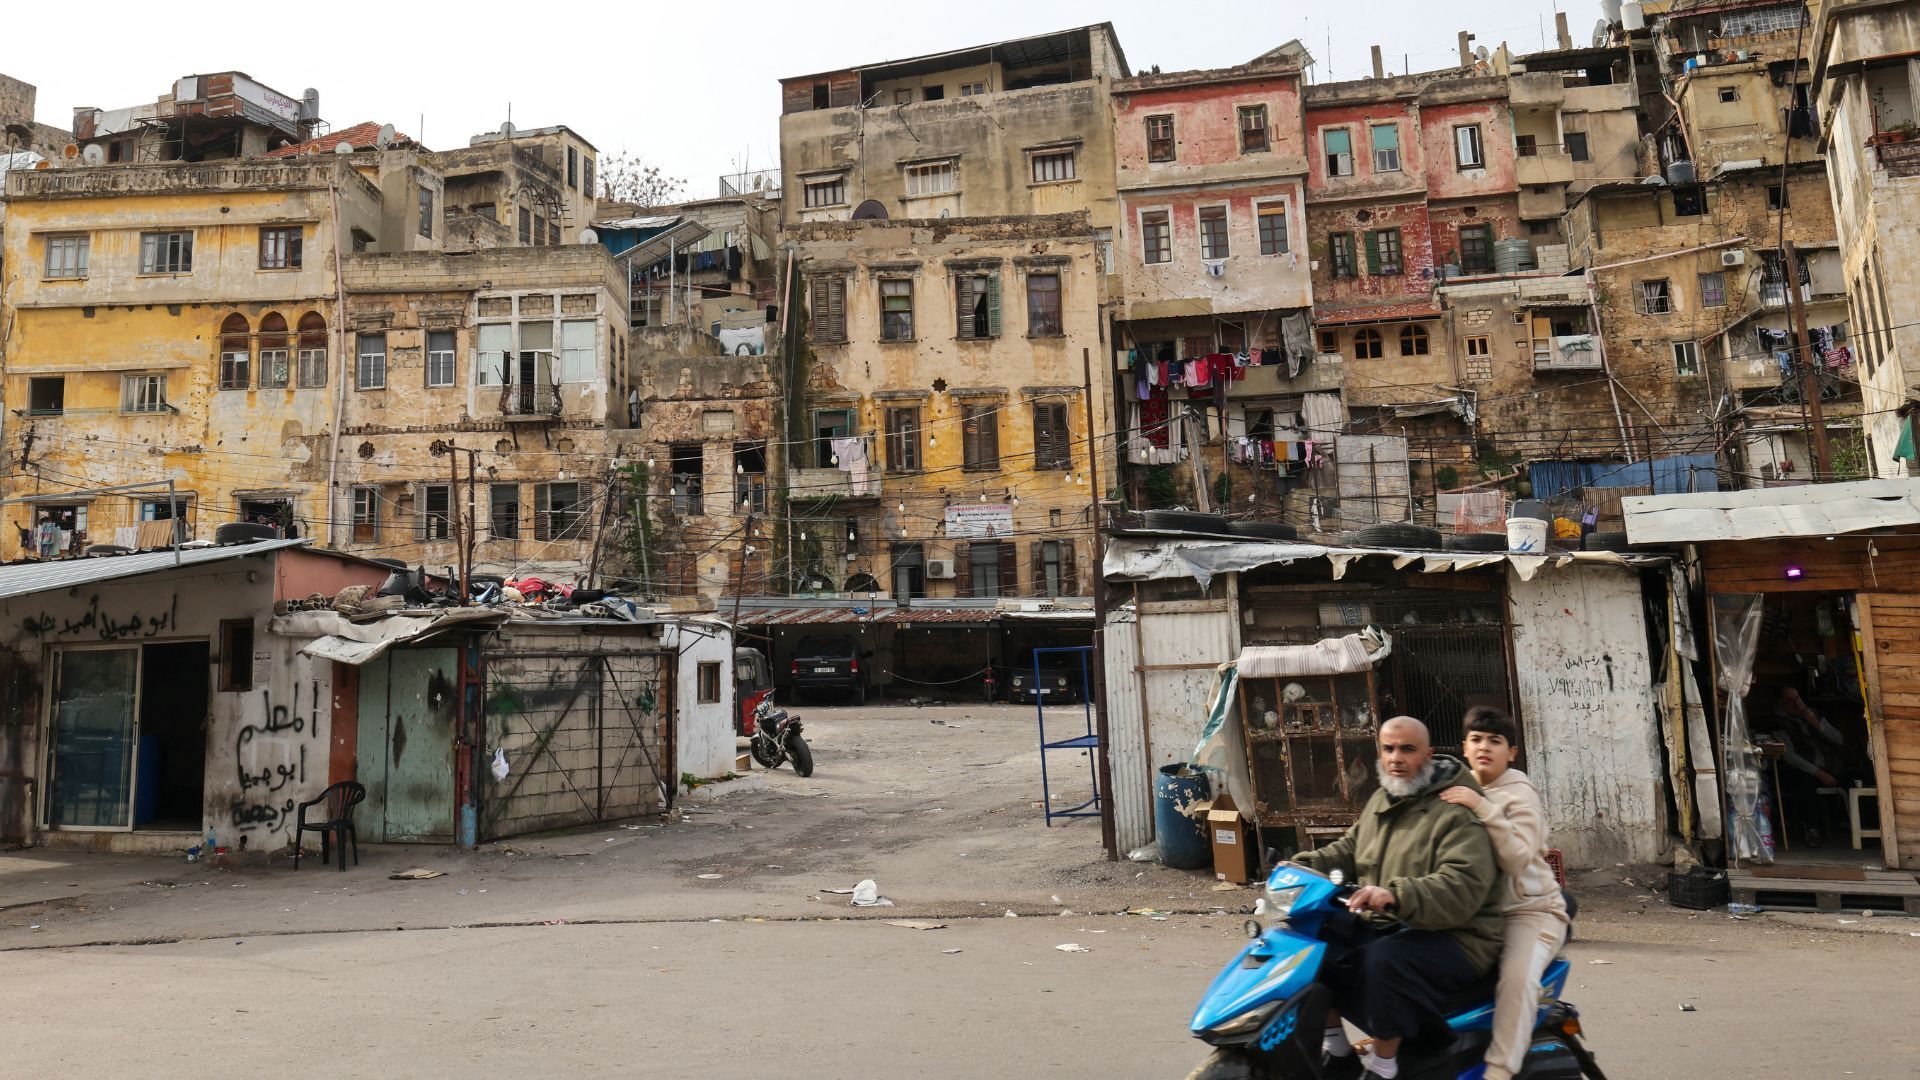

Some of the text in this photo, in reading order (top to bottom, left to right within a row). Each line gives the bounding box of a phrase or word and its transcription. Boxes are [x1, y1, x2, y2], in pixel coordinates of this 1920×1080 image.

[99, 611, 143, 640] جميل
[144, 593, 178, 637] ابو
[236, 680, 320, 772] المعلم
[270, 743, 306, 792] ابو
